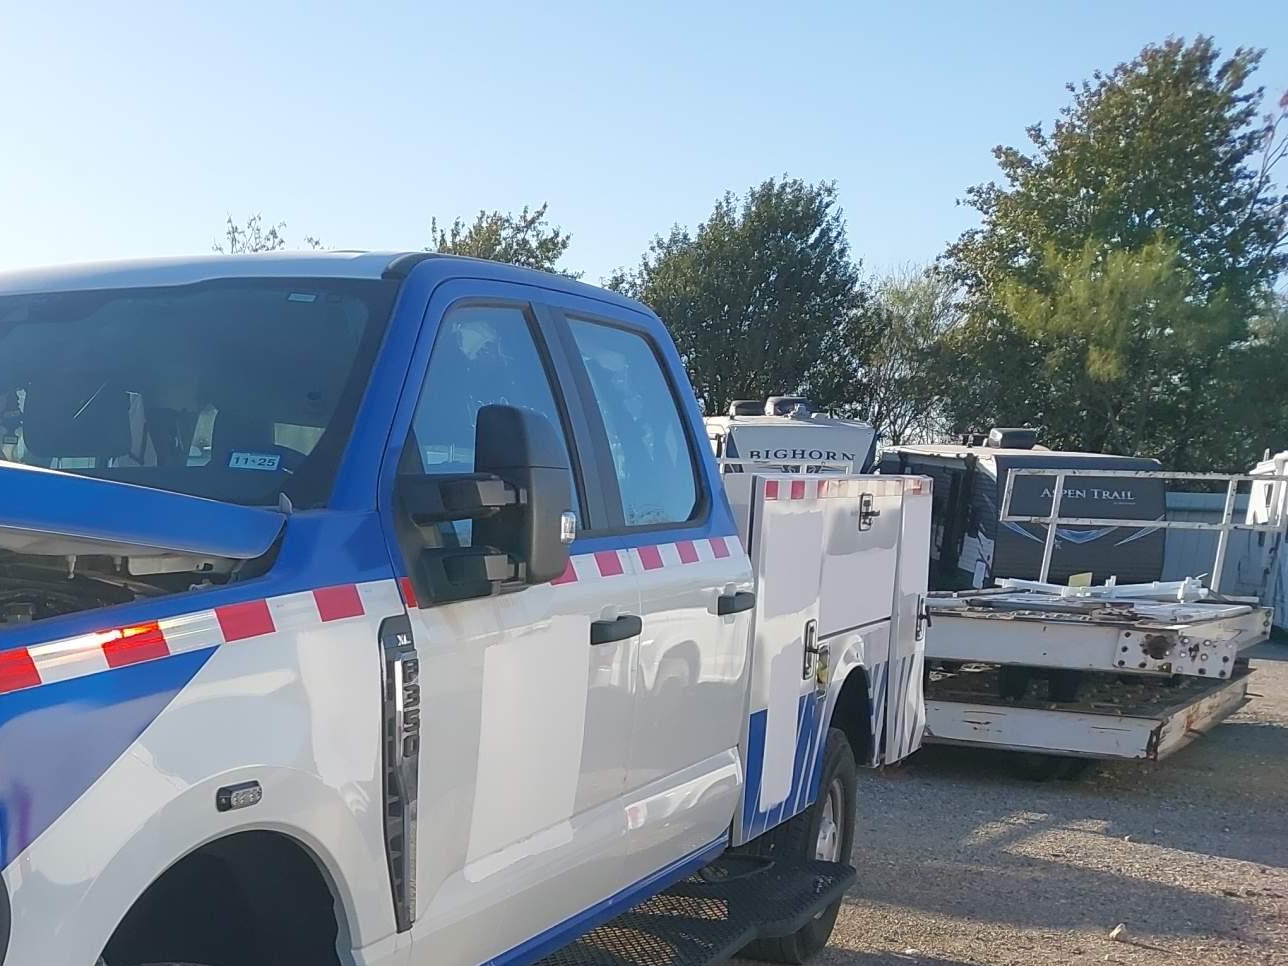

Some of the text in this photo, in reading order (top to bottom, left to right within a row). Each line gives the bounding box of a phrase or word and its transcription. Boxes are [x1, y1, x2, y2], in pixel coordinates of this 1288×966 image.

[749, 449, 855, 461] BIGHORN
[1040, 488, 1135, 500] APEN TRAIL
[396, 634, 412, 646] XL
